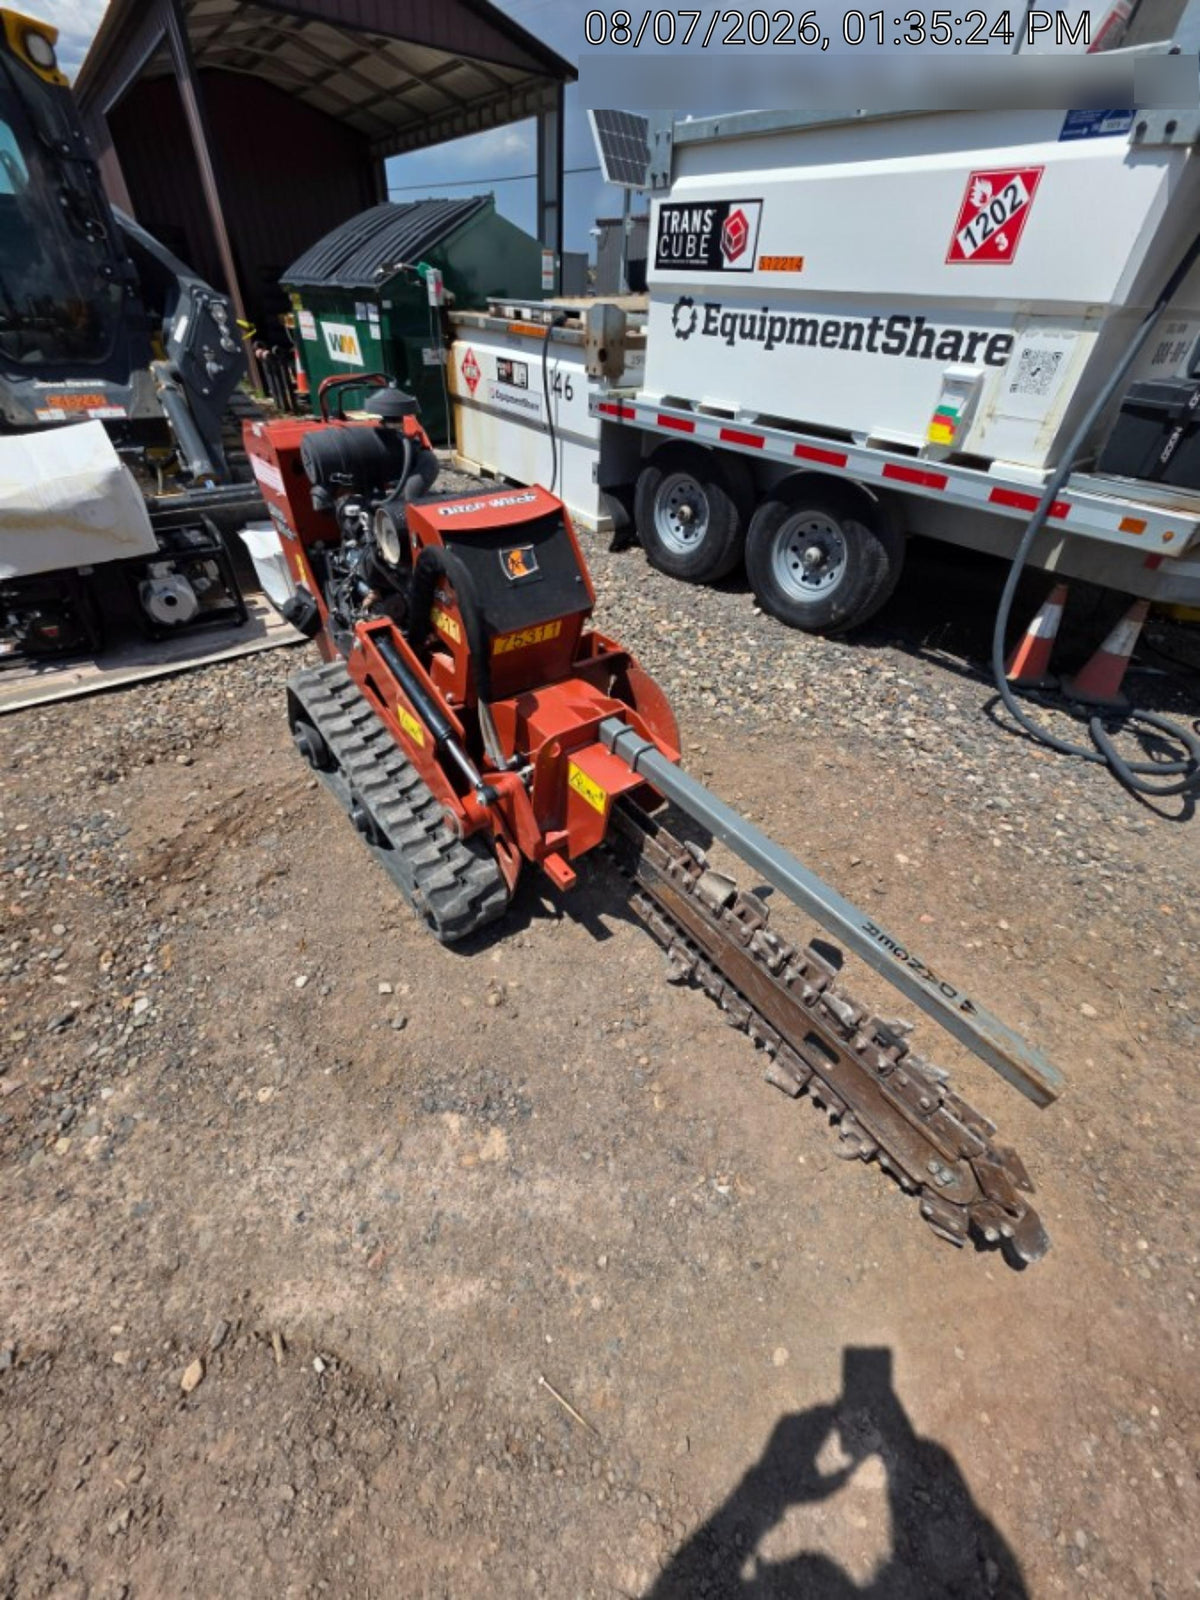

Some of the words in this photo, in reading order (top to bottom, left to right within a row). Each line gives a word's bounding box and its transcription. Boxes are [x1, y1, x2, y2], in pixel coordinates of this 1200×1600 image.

[661, 208, 714, 234] TRANS
[963, 184, 1023, 249] 1202
[658, 234, 711, 258] CUBE
[995, 232, 1009, 252] 3
[328, 331, 358, 356] WM
[701, 303, 1015, 367] EquipmentShare
